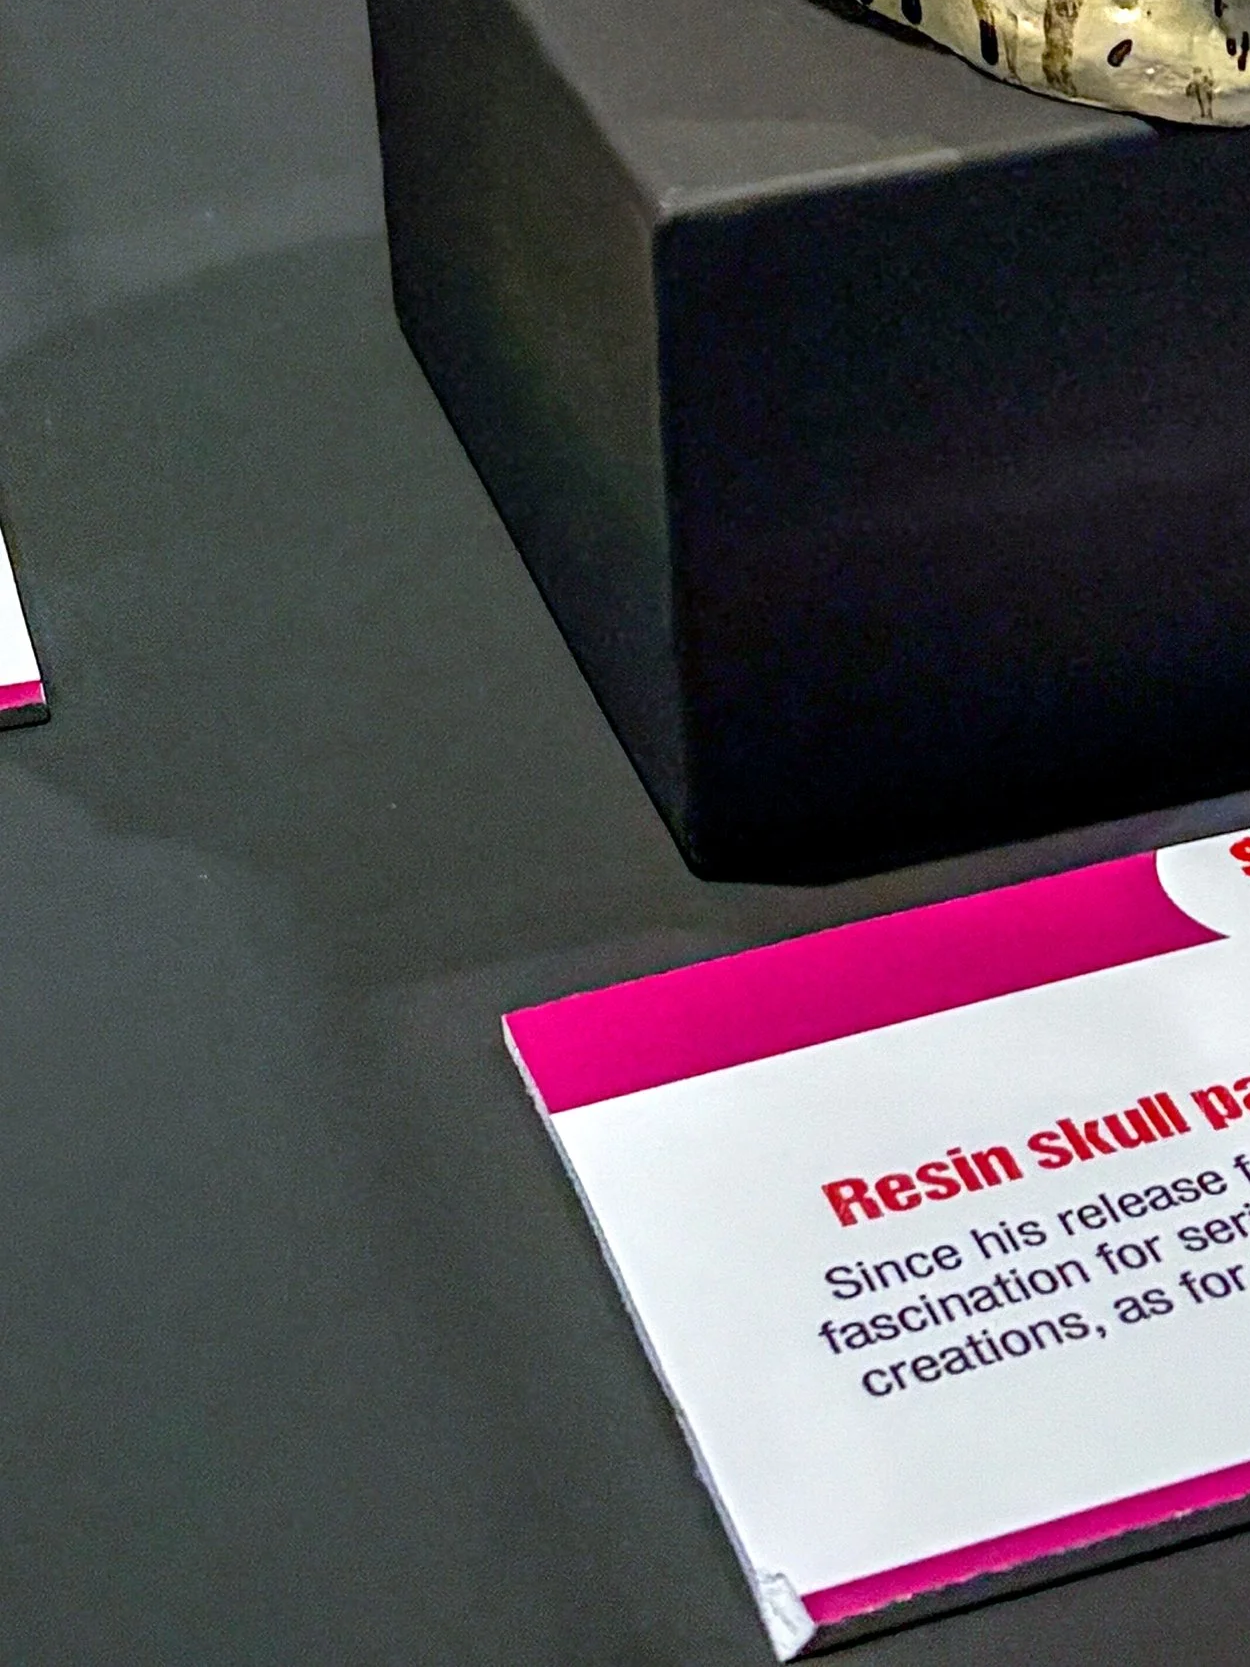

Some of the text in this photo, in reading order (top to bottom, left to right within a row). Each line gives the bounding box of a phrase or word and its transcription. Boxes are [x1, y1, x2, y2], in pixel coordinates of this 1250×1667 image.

[821, 1146, 1024, 1227] Resin
[1027, 1092, 1192, 1170] skull
[818, 1260, 1091, 1355] fascination
[1095, 1235, 1162, 1275] for
[824, 1244, 963, 1300] Since
[969, 1220, 1047, 1260] his
[1057, 1170, 1228, 1236] release
[862, 1312, 1107, 1397] creations,
[1113, 1288, 1174, 1324] as
[1178, 1264, 1246, 1304] for
